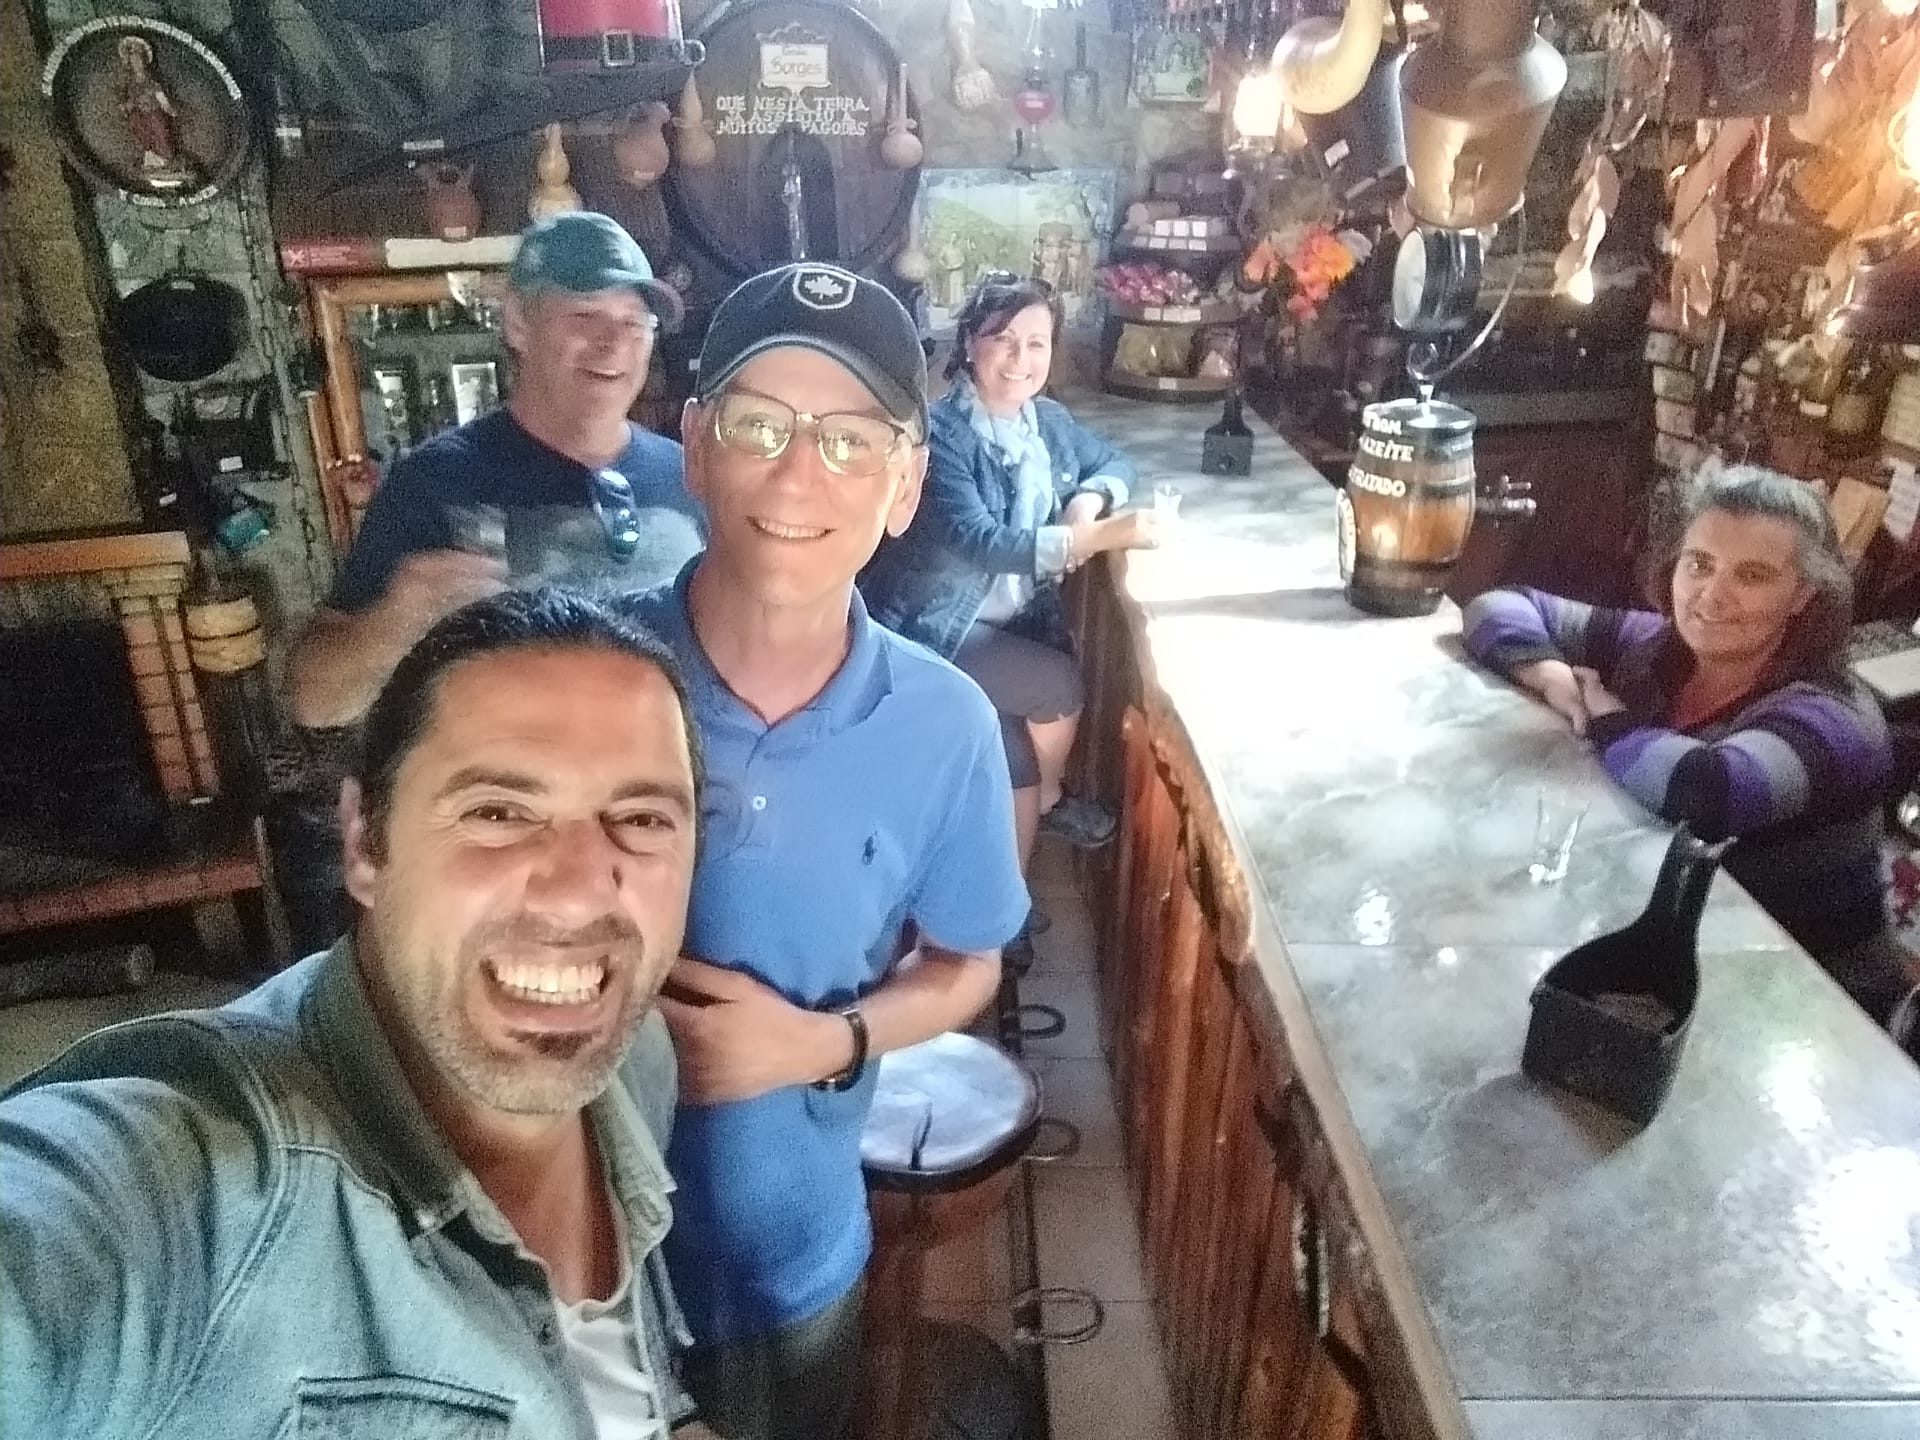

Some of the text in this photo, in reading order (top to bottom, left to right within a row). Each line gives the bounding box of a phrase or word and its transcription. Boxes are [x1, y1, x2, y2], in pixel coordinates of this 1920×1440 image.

[769, 56, 824, 77] Borges
[715, 95, 747, 111] QUE
[754, 95, 808, 112] NESTA
